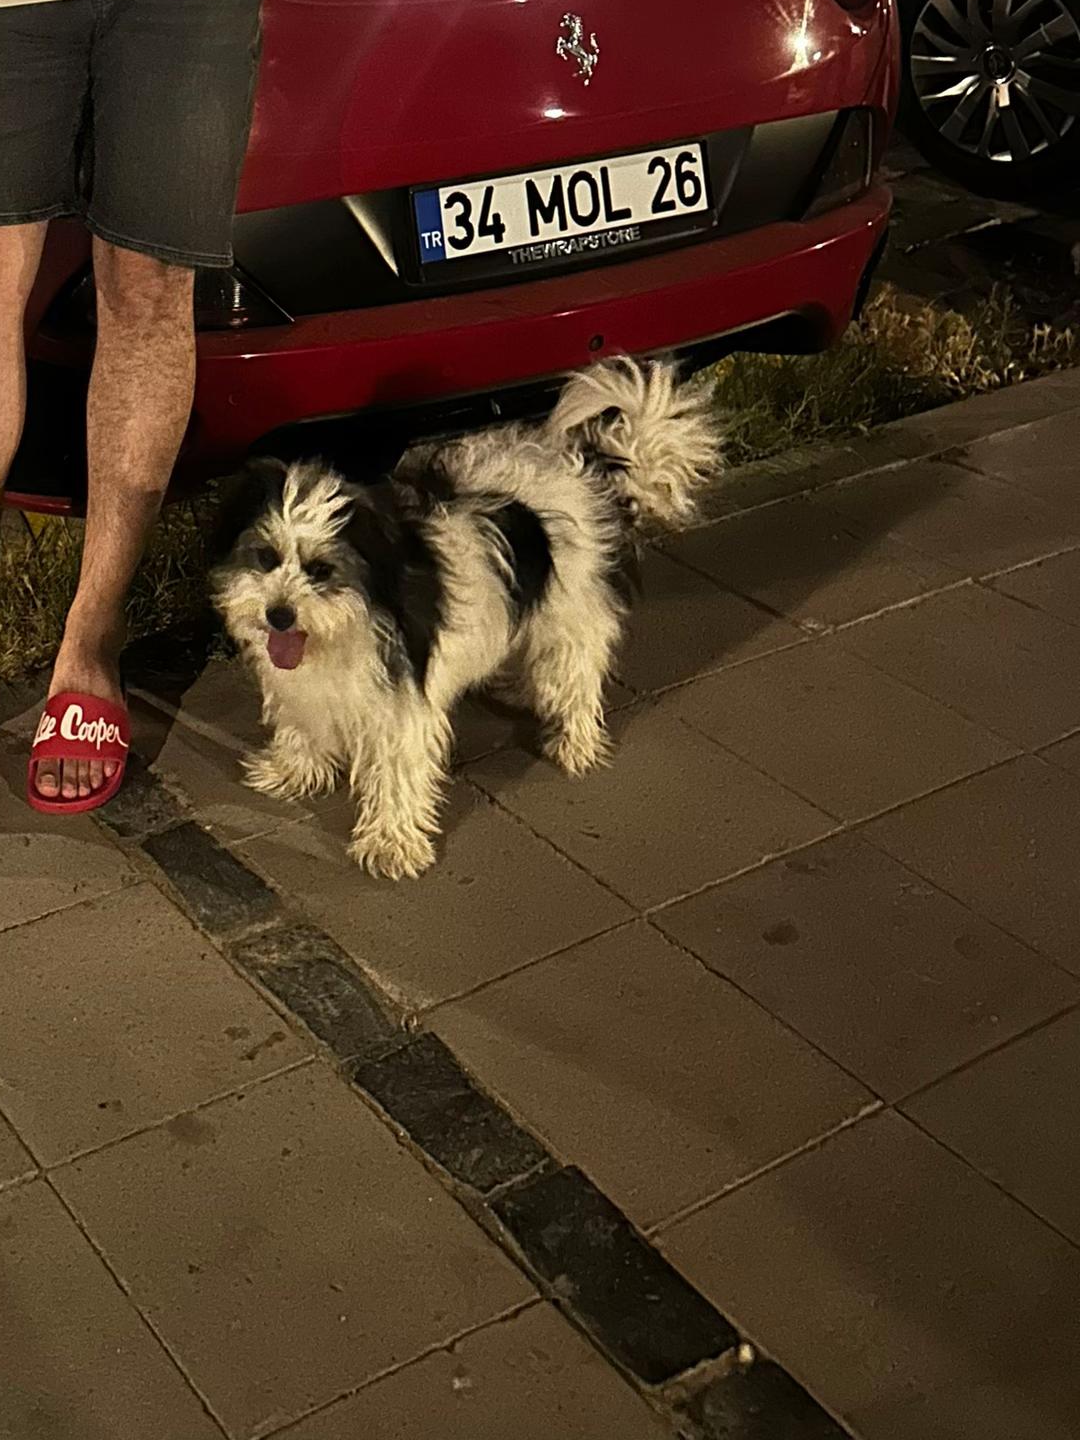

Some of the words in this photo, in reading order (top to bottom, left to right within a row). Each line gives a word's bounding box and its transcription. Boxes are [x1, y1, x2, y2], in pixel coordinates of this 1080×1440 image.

[444, 185, 505, 250] 34
[525, 166, 632, 237] MOL
[647, 151, 702, 214] 26
[421, 231, 442, 249] TR
[60, 704, 129, 750] Cooper
